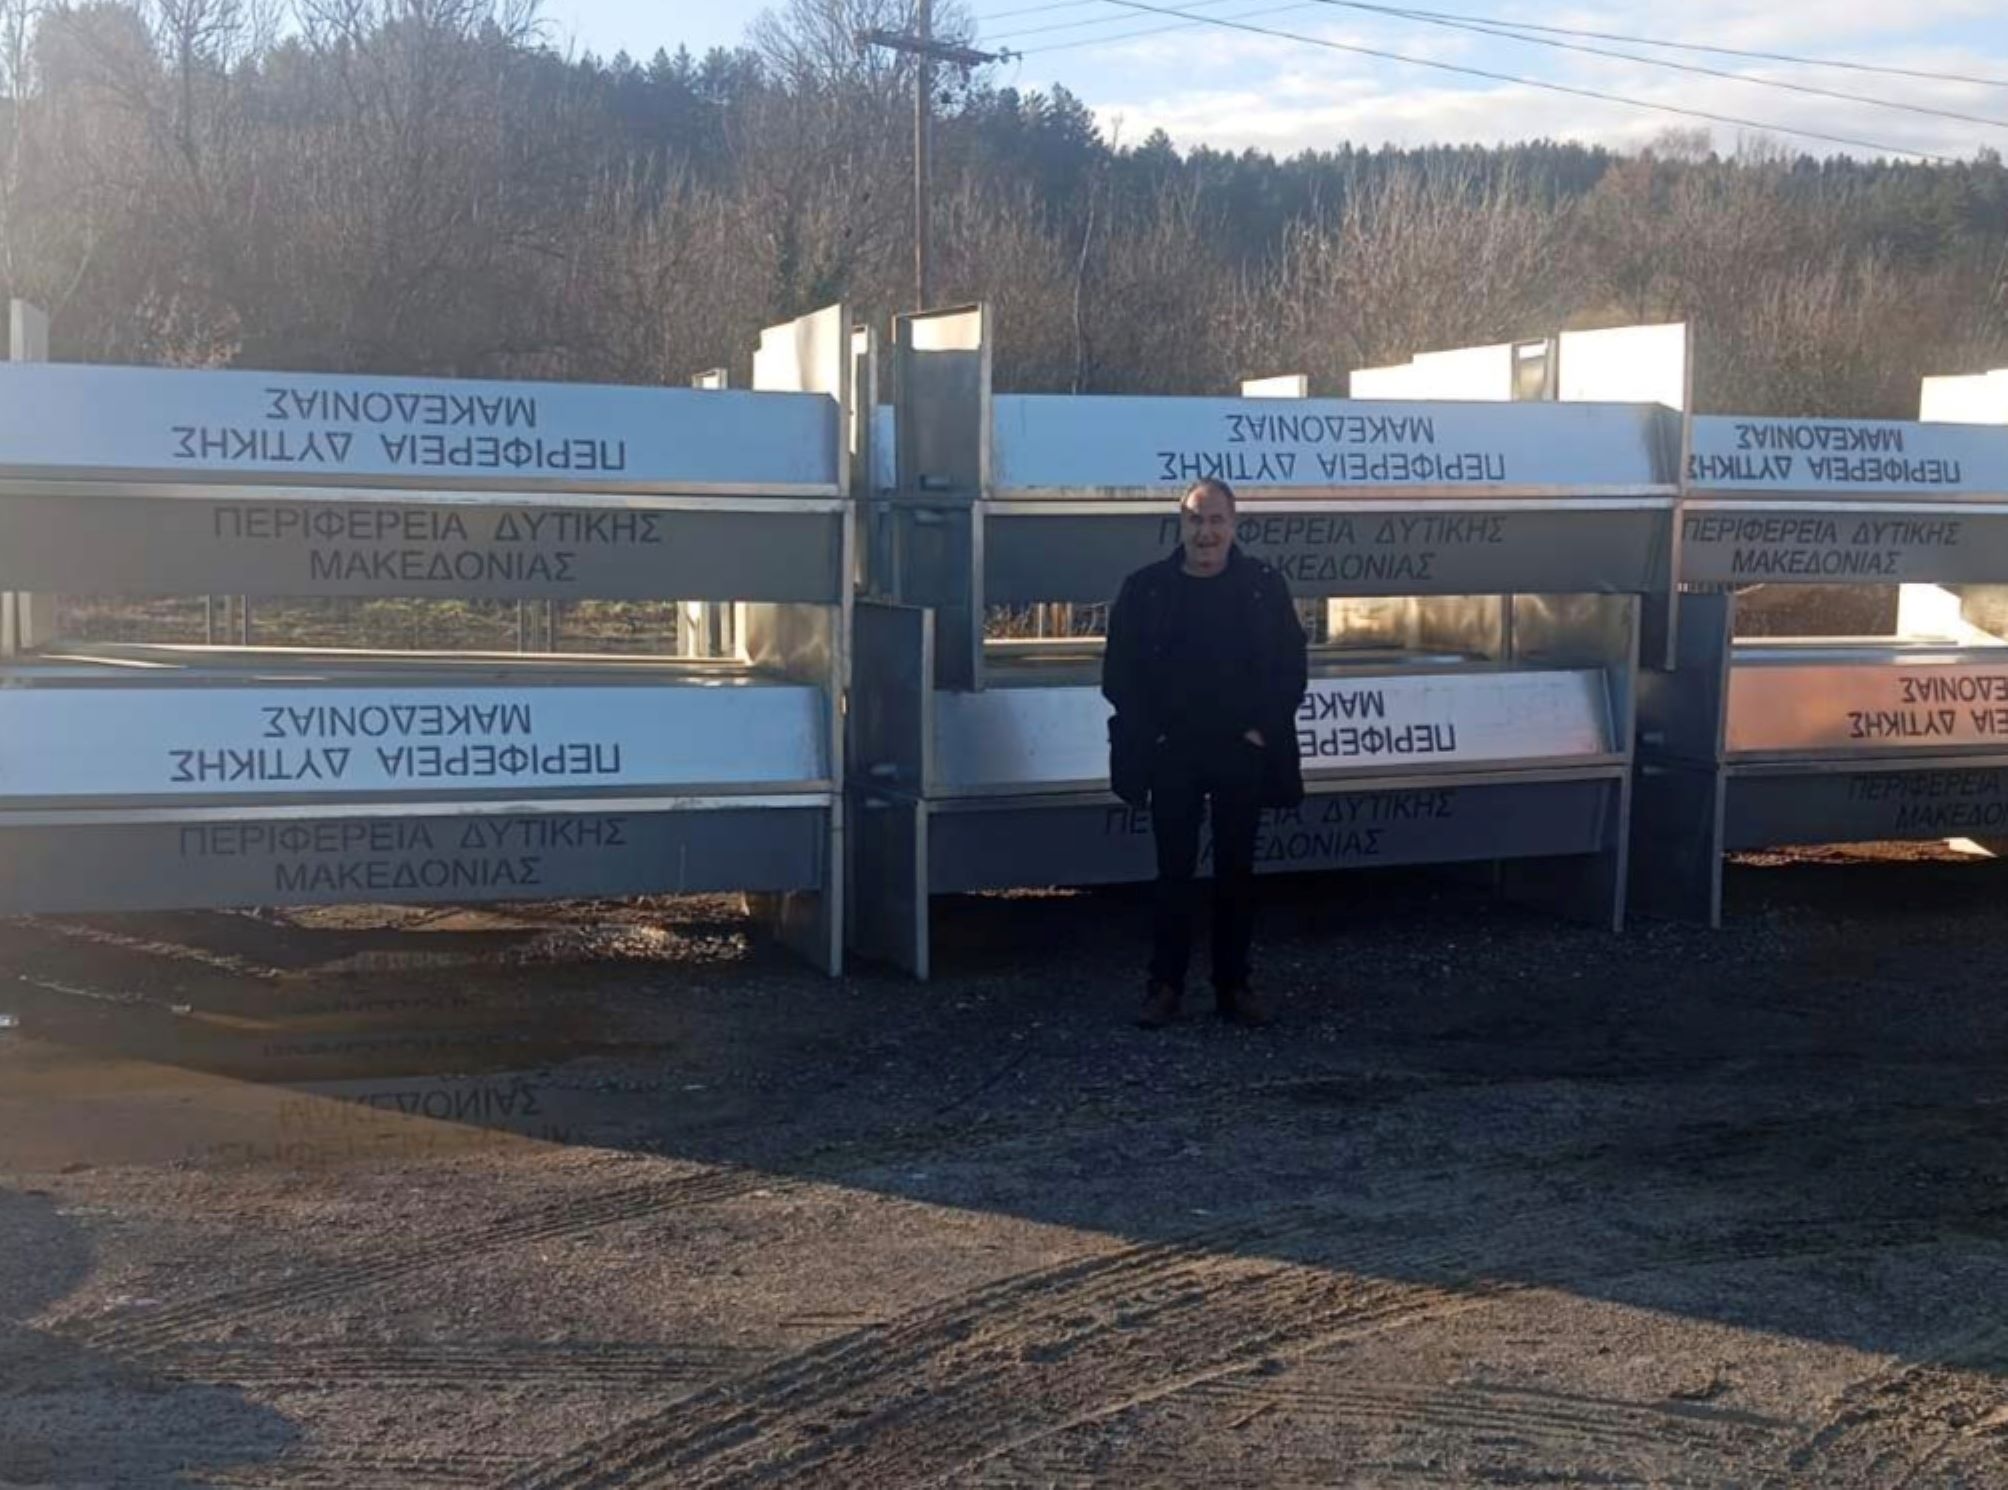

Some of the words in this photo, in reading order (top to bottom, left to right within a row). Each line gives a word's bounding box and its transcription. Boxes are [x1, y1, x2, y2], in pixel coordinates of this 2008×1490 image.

[265, 388, 536, 427] ΜΑΚΕΔΟΝΙΑΣ
[172, 427, 351, 461] ΔΥΤΙΚΗΣ
[1226, 415, 1434, 443] ΜΑΚΕΔΟΝΙΑΣ
[1735, 424, 1904, 452] ΜΑΚΕΔΟΝΙΑΣ
[381, 434, 627, 471] ΠΕΡΙΦΕΡΕΙΑ
[1157, 450, 1296, 482] ΔΥΤΙΚΗΣ
[1318, 452, 1506, 480] ΠΕΡΙΦΕΡΕΙΑ
[1808, 457, 1961, 483] ΠΕΡΙΦΕΡΕΙΑ
[214, 507, 467, 541] ΠΕΡΙΦΕΡΕΙΑ
[494, 513, 663, 544] ΔΥΤΙΚΗΣ
[1160, 518, 1356, 545] ΠΦΕΡΕΙΑ
[1374, 516, 1507, 544] ΔΥΤΙΚΗΣ
[1683, 519, 1838, 543] ΠΕΡΙΦΕΡΕΙΑ
[1852, 520, 1962, 546] ΔΥΤΙΚΗΣ
[309, 551, 577, 583] ΜΑΚΕΔΟΝΙΑΣ
[1275, 552, 1436, 581] ΚΕΔΟΝΙΑΣ
[1731, 550, 1902, 575] ΜΑΚΕΔΟΝΙΑΣ
[1900, 674, 2008, 702] ΕΔΟΝΙΑΣ
[262, 705, 532, 737] ΜΑΚΕΔΟΝΙΑΣ
[1848, 708, 1956, 738] ΔΥΤΙΚΗΣ
[1299, 724, 1457, 758] ΠΕΡΙΦΕΡΕ
[169, 748, 348, 783] ΔΥΤΙΚΗΣ
[377, 744, 620, 773] ΠΕΡΙΦΕΡΕΙΑ
[1322, 792, 1454, 824] ΔΥΤΙΚΗΣ
[1895, 802, 2008, 833] ΜΑΚΕΔΟ
[178, 822, 433, 857] ΠΕΡΙΦΕΡΕΙΑ
[461, 817, 628, 849] ΔΥΤΙΚΗΣ
[1253, 830, 1382, 861] ΕΔΟΝΙΑΣ
[275, 856, 541, 893] ΜΑΚΕΔΟΝΙΑΣ
